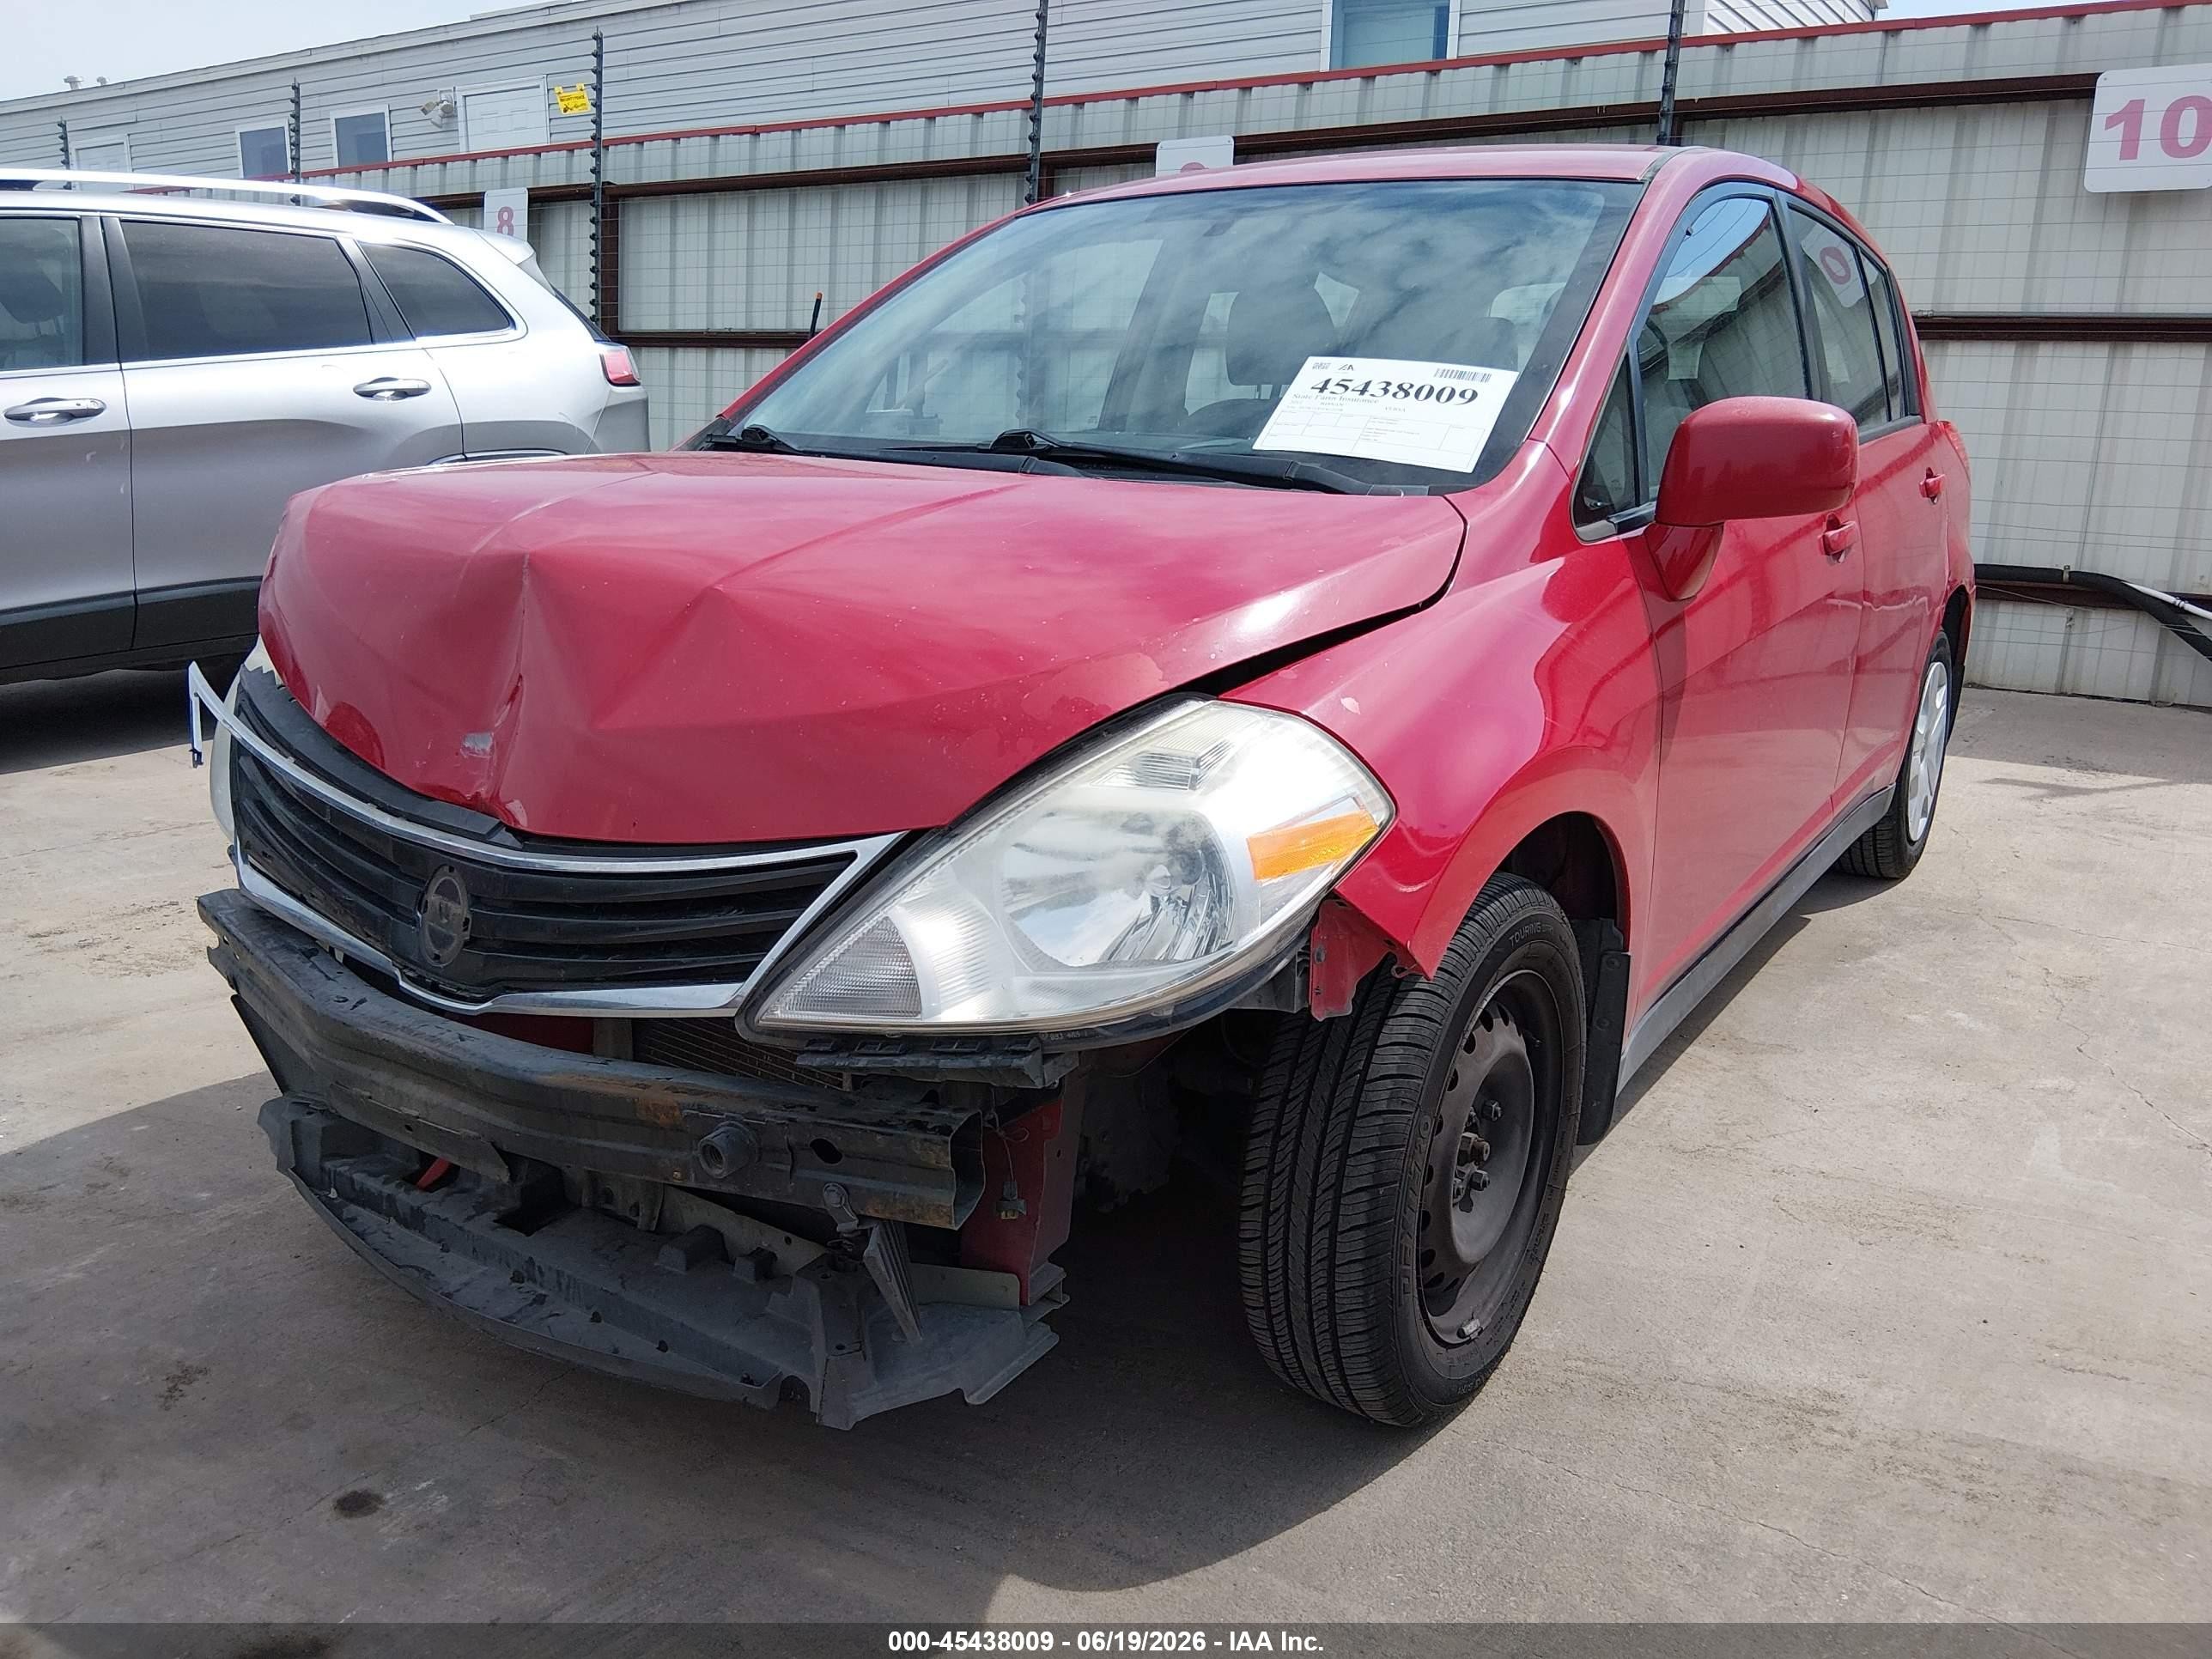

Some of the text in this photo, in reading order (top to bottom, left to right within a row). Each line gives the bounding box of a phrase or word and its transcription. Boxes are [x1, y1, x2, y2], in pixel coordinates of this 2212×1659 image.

[2104, 94, 2212, 161] 10
[496, 205, 514, 236] 8
[1310, 377, 1479, 405] 45438009
[1339, 395, 1380, 404] Insurance
[1509, 921, 1541, 948] TOURING
